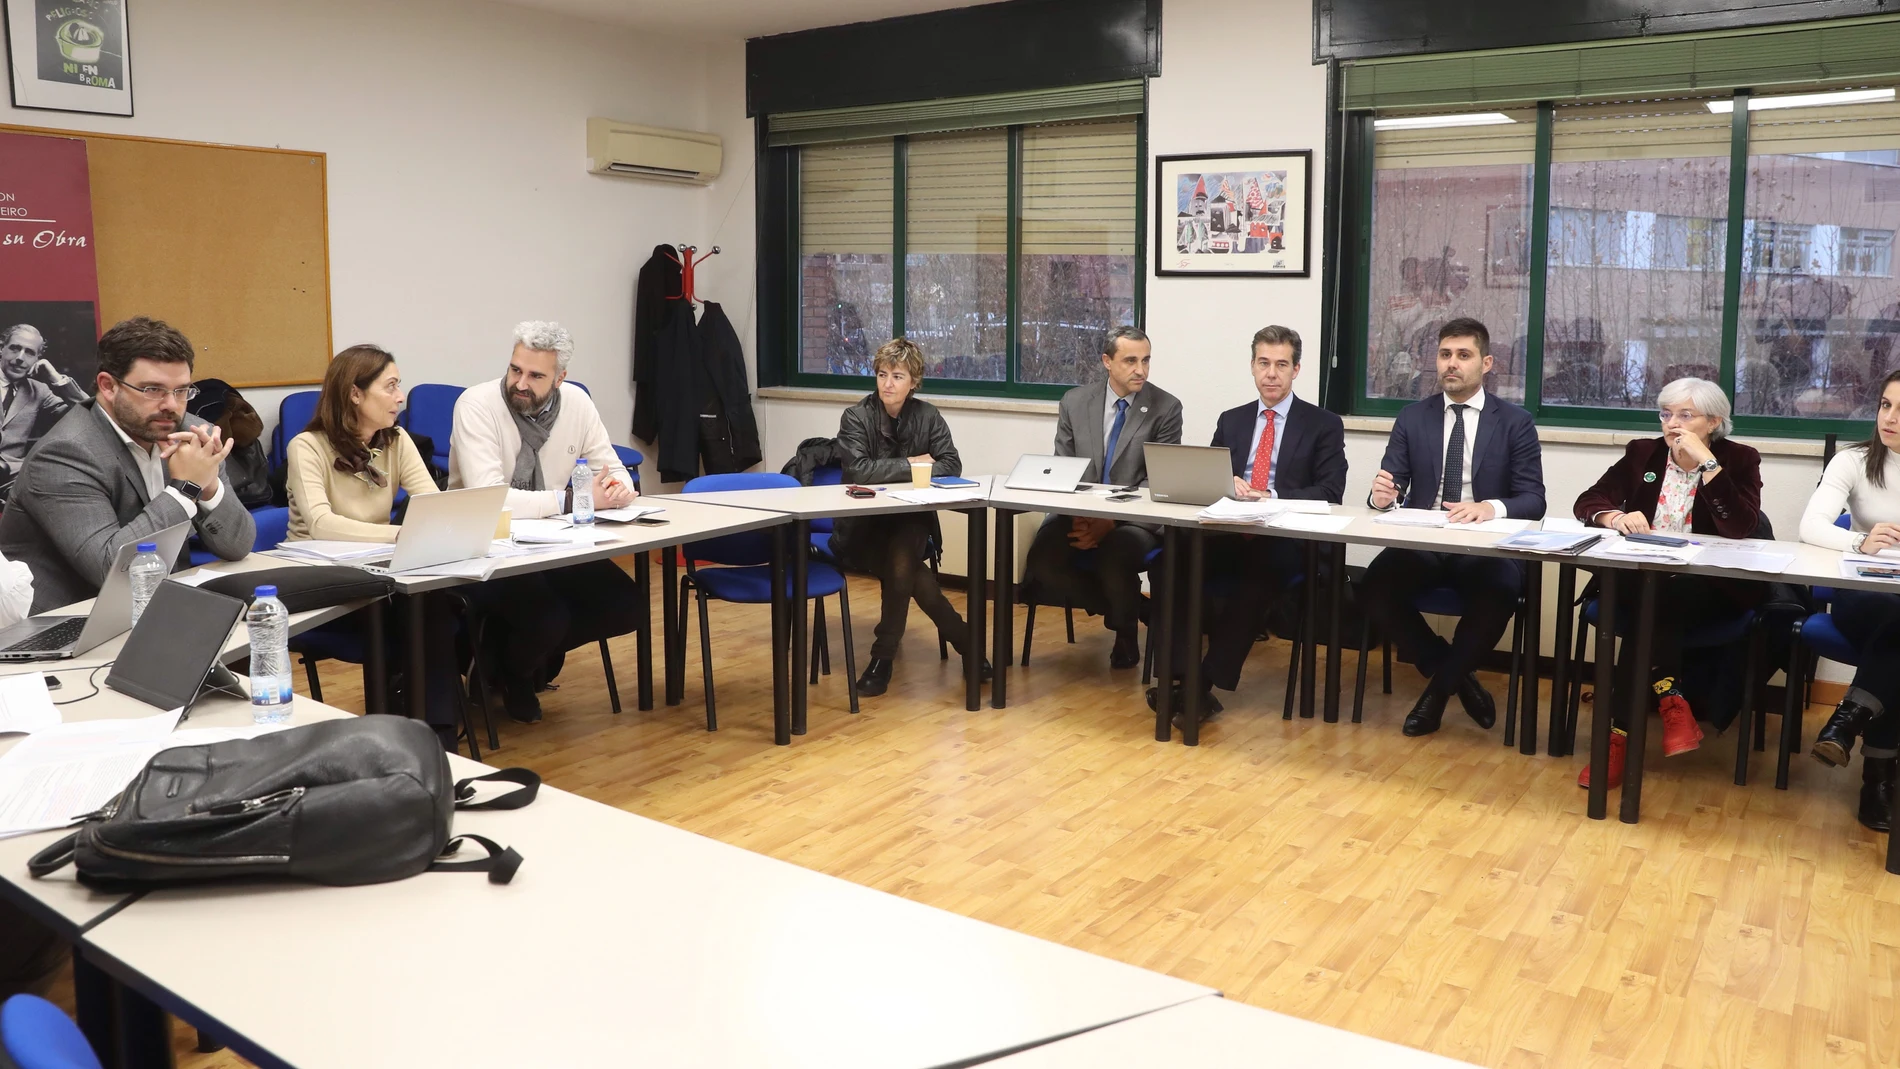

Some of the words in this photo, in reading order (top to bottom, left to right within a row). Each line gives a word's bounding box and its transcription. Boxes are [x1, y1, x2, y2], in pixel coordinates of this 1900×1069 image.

[63, 62, 78, 74] NI
[79, 73, 116, 89] BROMA
[0, 206, 28, 217] EIRO
[3, 233, 25, 246] su
[33, 230, 87, 249] Obra
